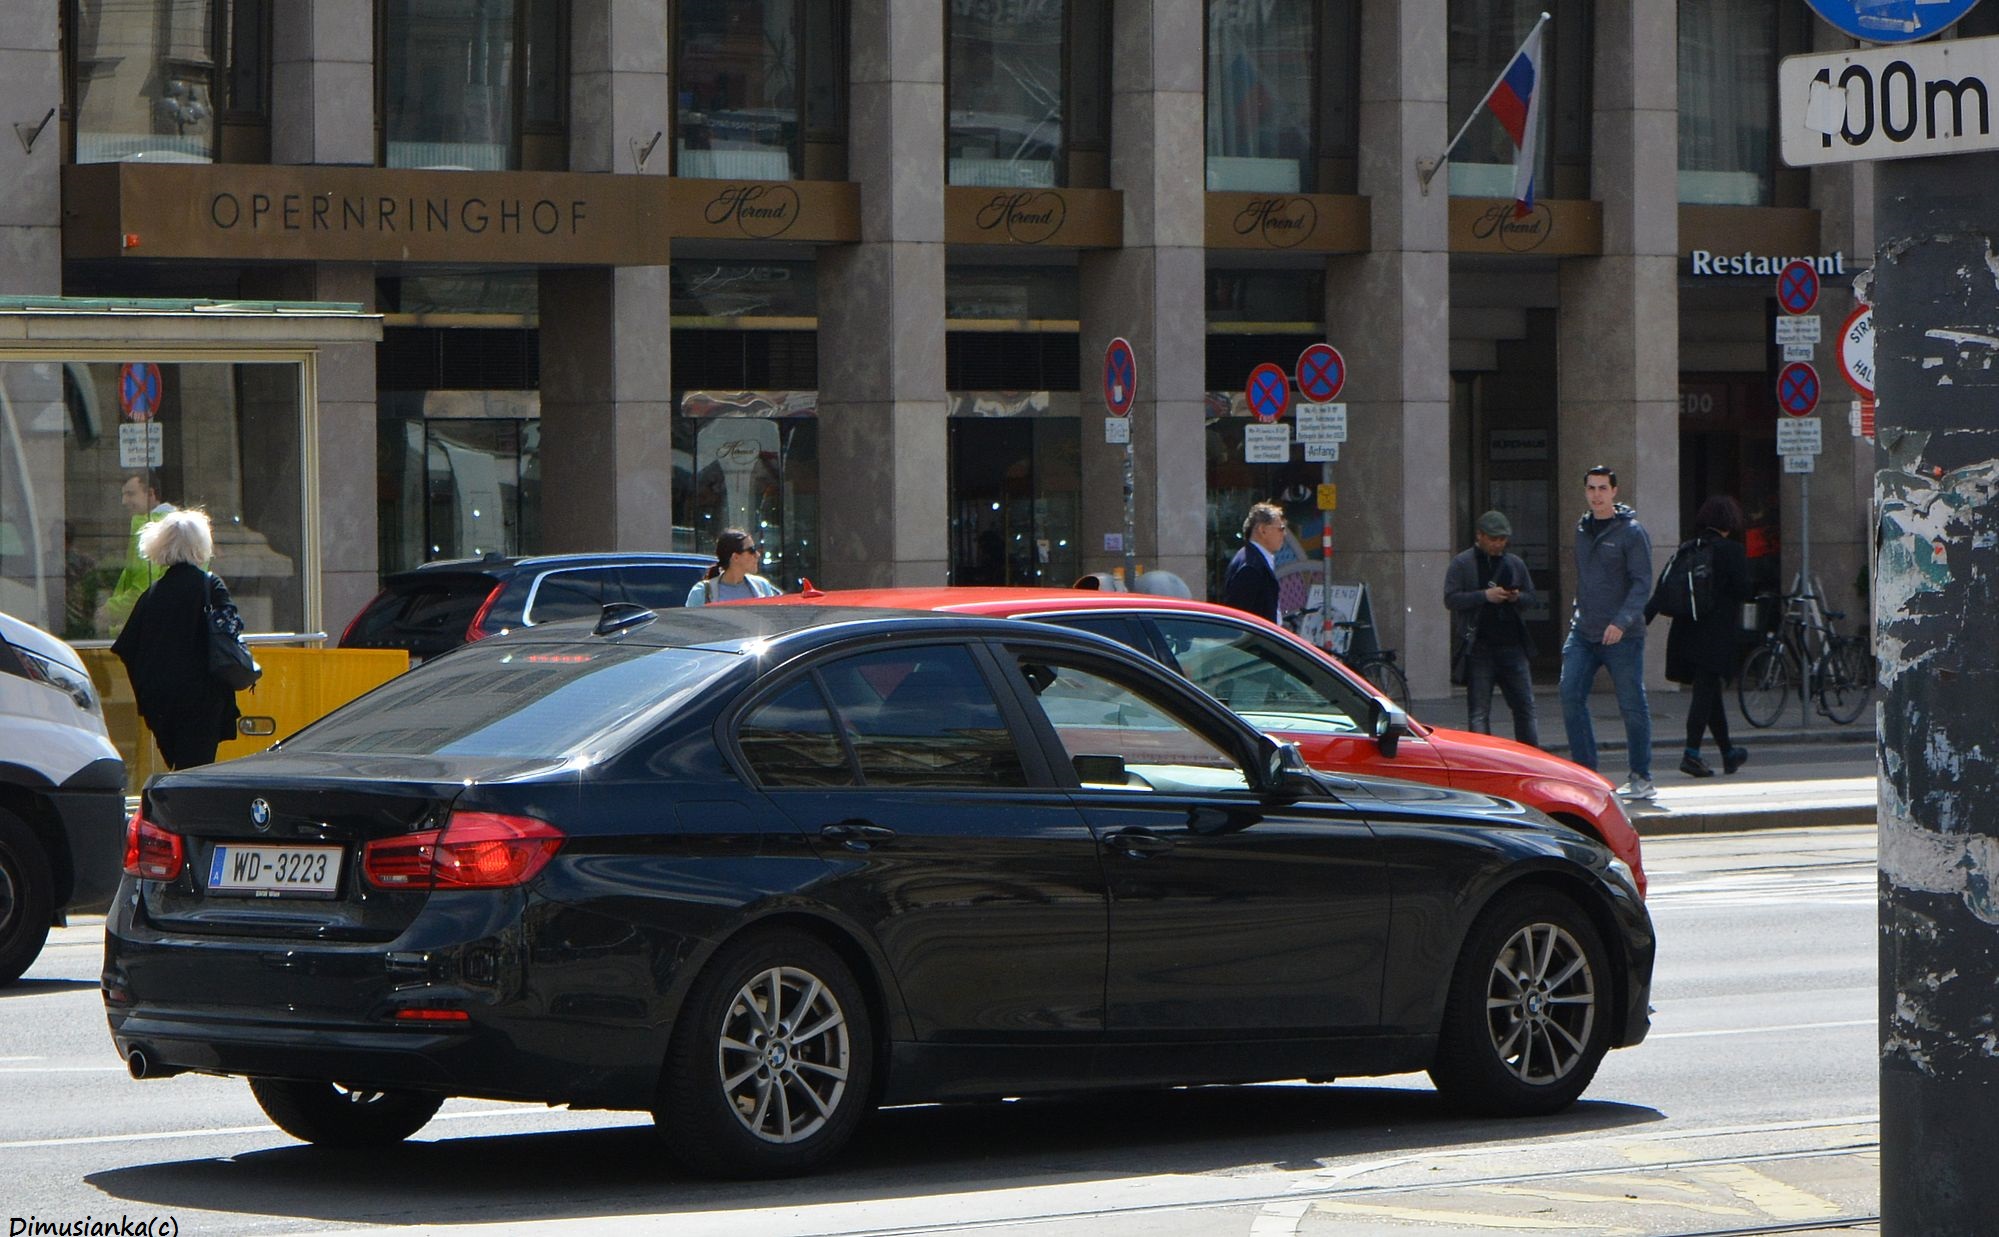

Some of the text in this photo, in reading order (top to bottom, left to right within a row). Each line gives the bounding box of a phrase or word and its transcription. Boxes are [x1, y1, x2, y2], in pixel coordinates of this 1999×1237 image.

[210, 192, 588, 236] OPERNRINGHOF
[1308, 445, 1336, 459] Anfang
[1313, 588, 1357, 599] HEND
[234, 852, 327, 884] WD-3223
[213, 872, 220, 881] A
